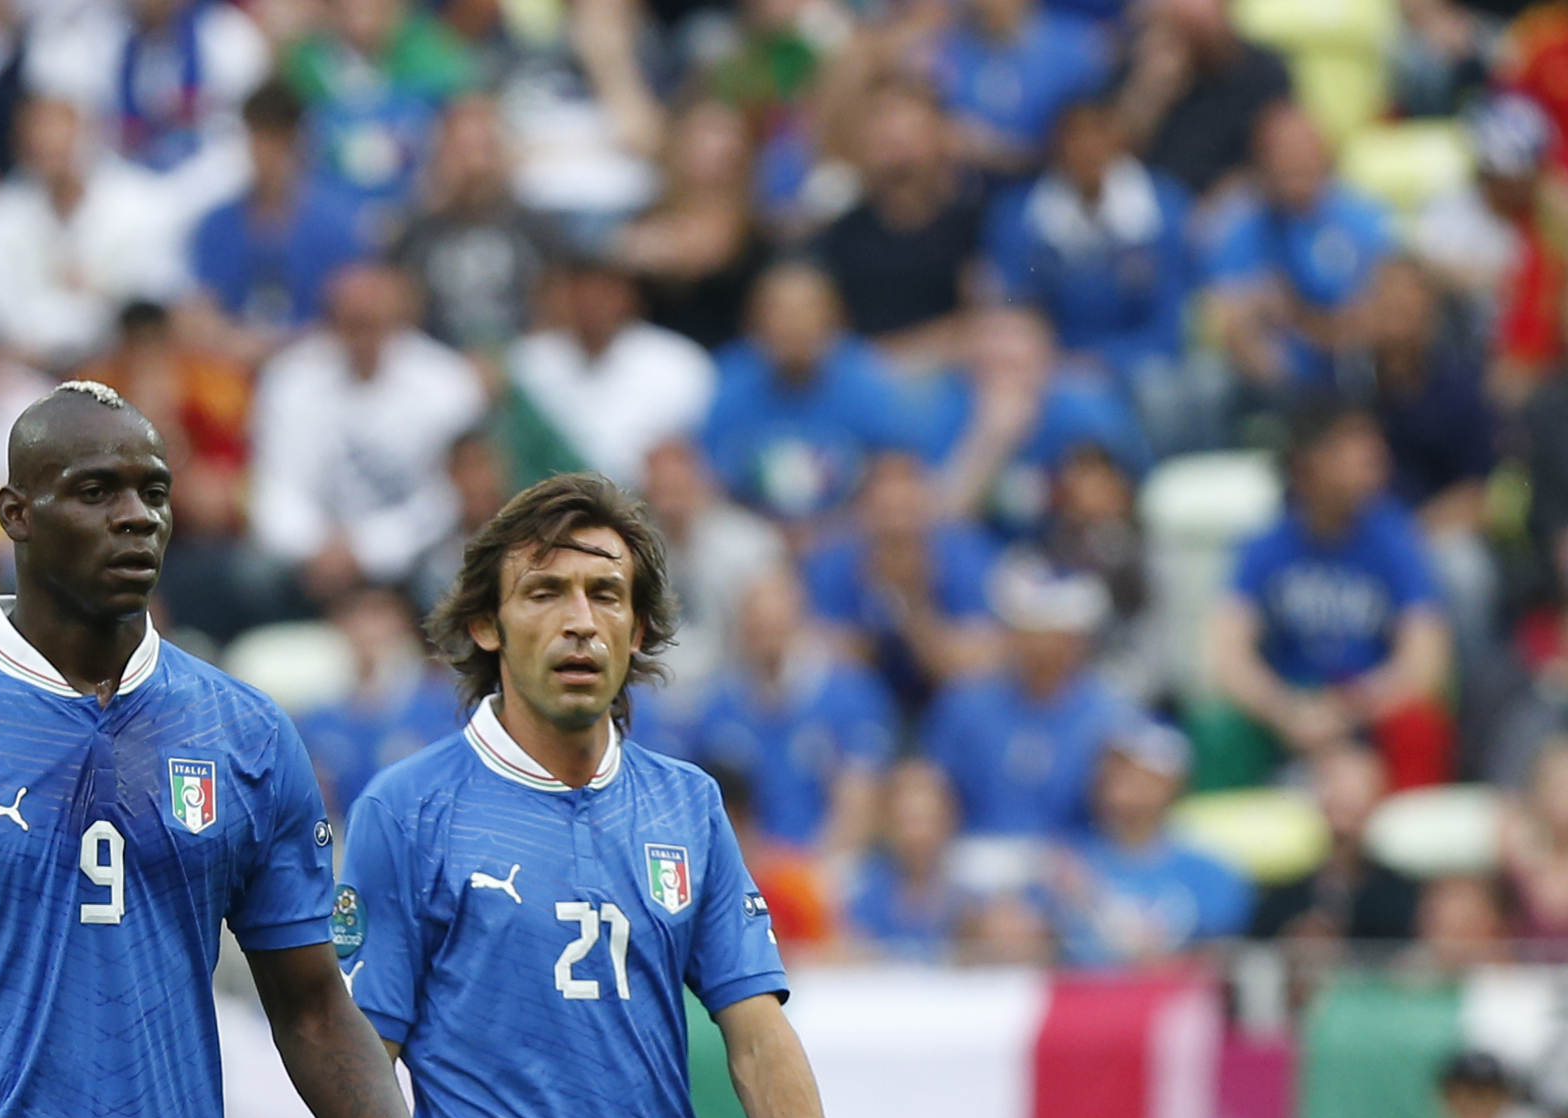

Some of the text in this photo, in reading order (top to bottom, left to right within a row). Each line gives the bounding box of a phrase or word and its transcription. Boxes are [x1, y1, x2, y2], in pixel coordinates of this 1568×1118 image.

[174, 764, 208, 776] ITALIA
[79, 820, 125, 924] 9
[554, 901, 631, 1000] 21
